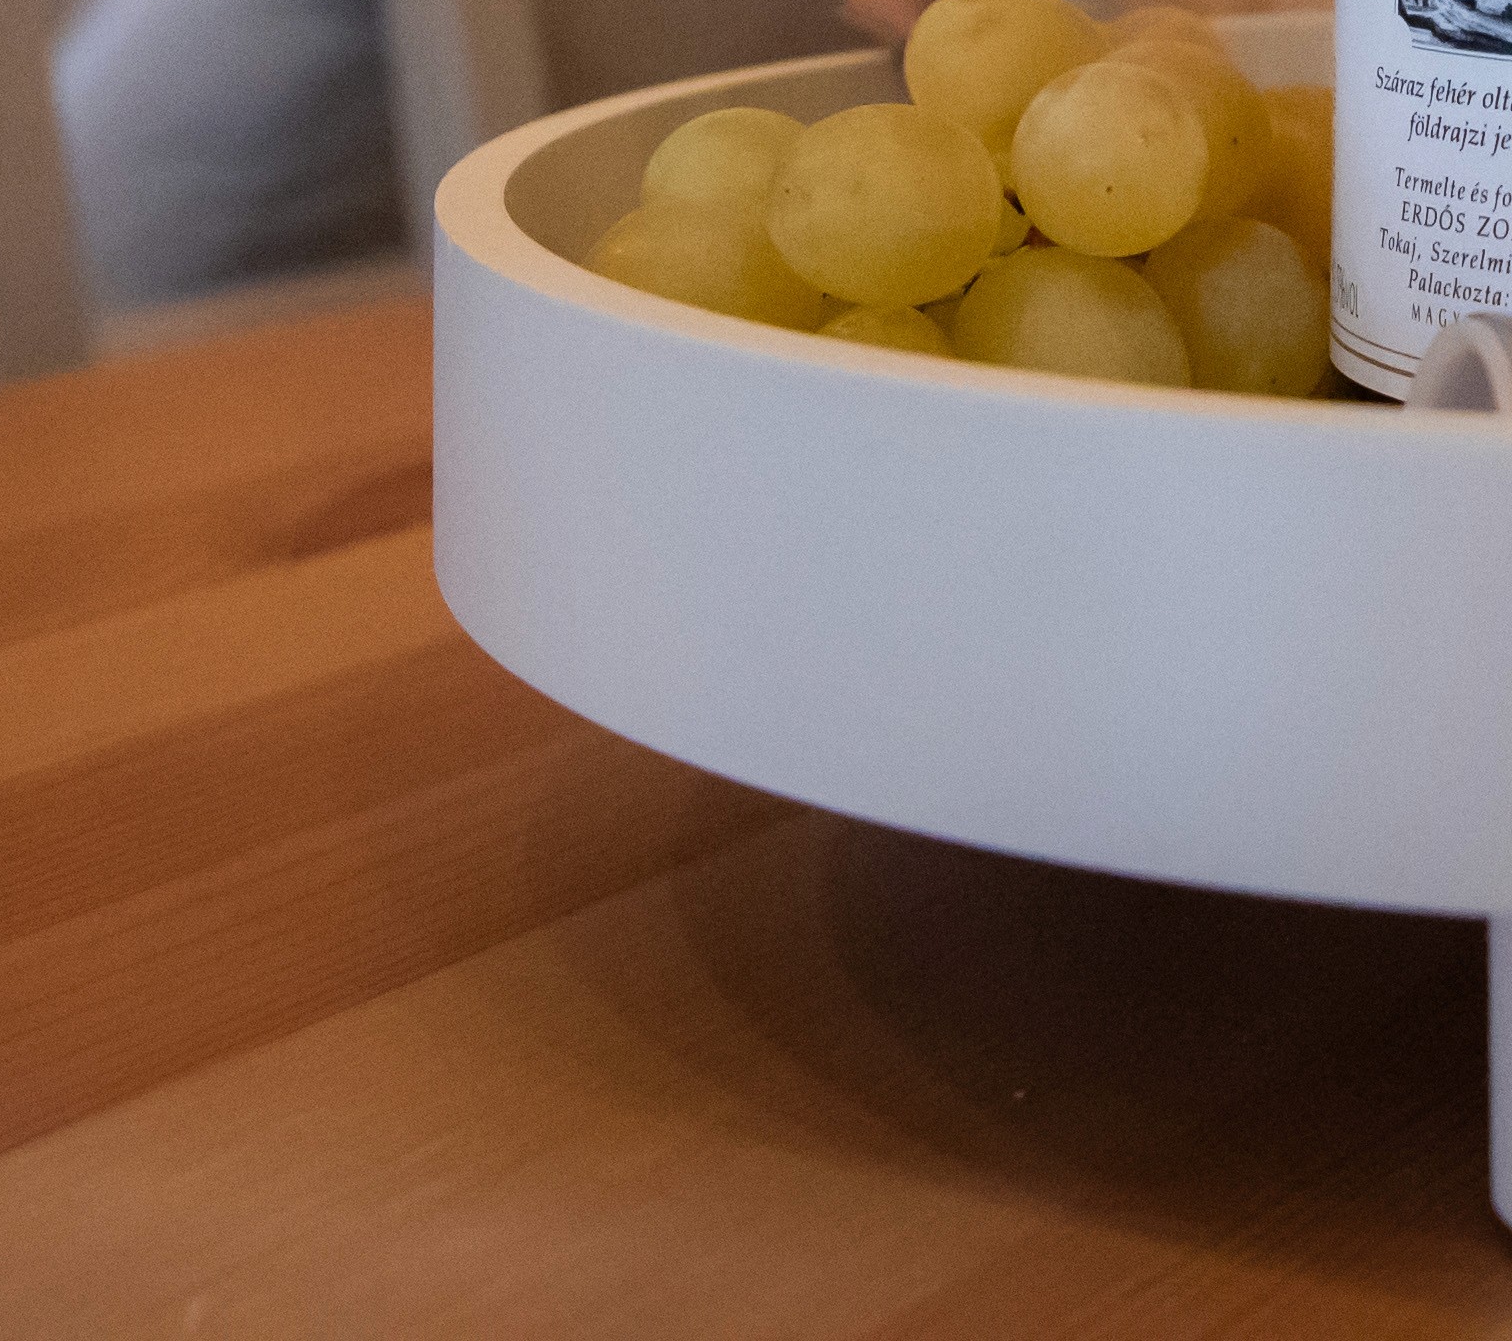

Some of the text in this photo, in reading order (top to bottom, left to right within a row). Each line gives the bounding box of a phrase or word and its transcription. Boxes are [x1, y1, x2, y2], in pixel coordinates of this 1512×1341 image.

[1375, 66, 1425, 98] Száraz
[1426, 77, 1477, 107] fehér
[1408, 111, 1488, 152] földrajzi
[1395, 167, 1466, 202] Termelte
[1470, 181, 1489, 204] és
[1379, 227, 1422, 262] Tokaj,
[1430, 241, 1512, 274] Szerelmi
[1408, 268, 1510, 307] Palackozta:
